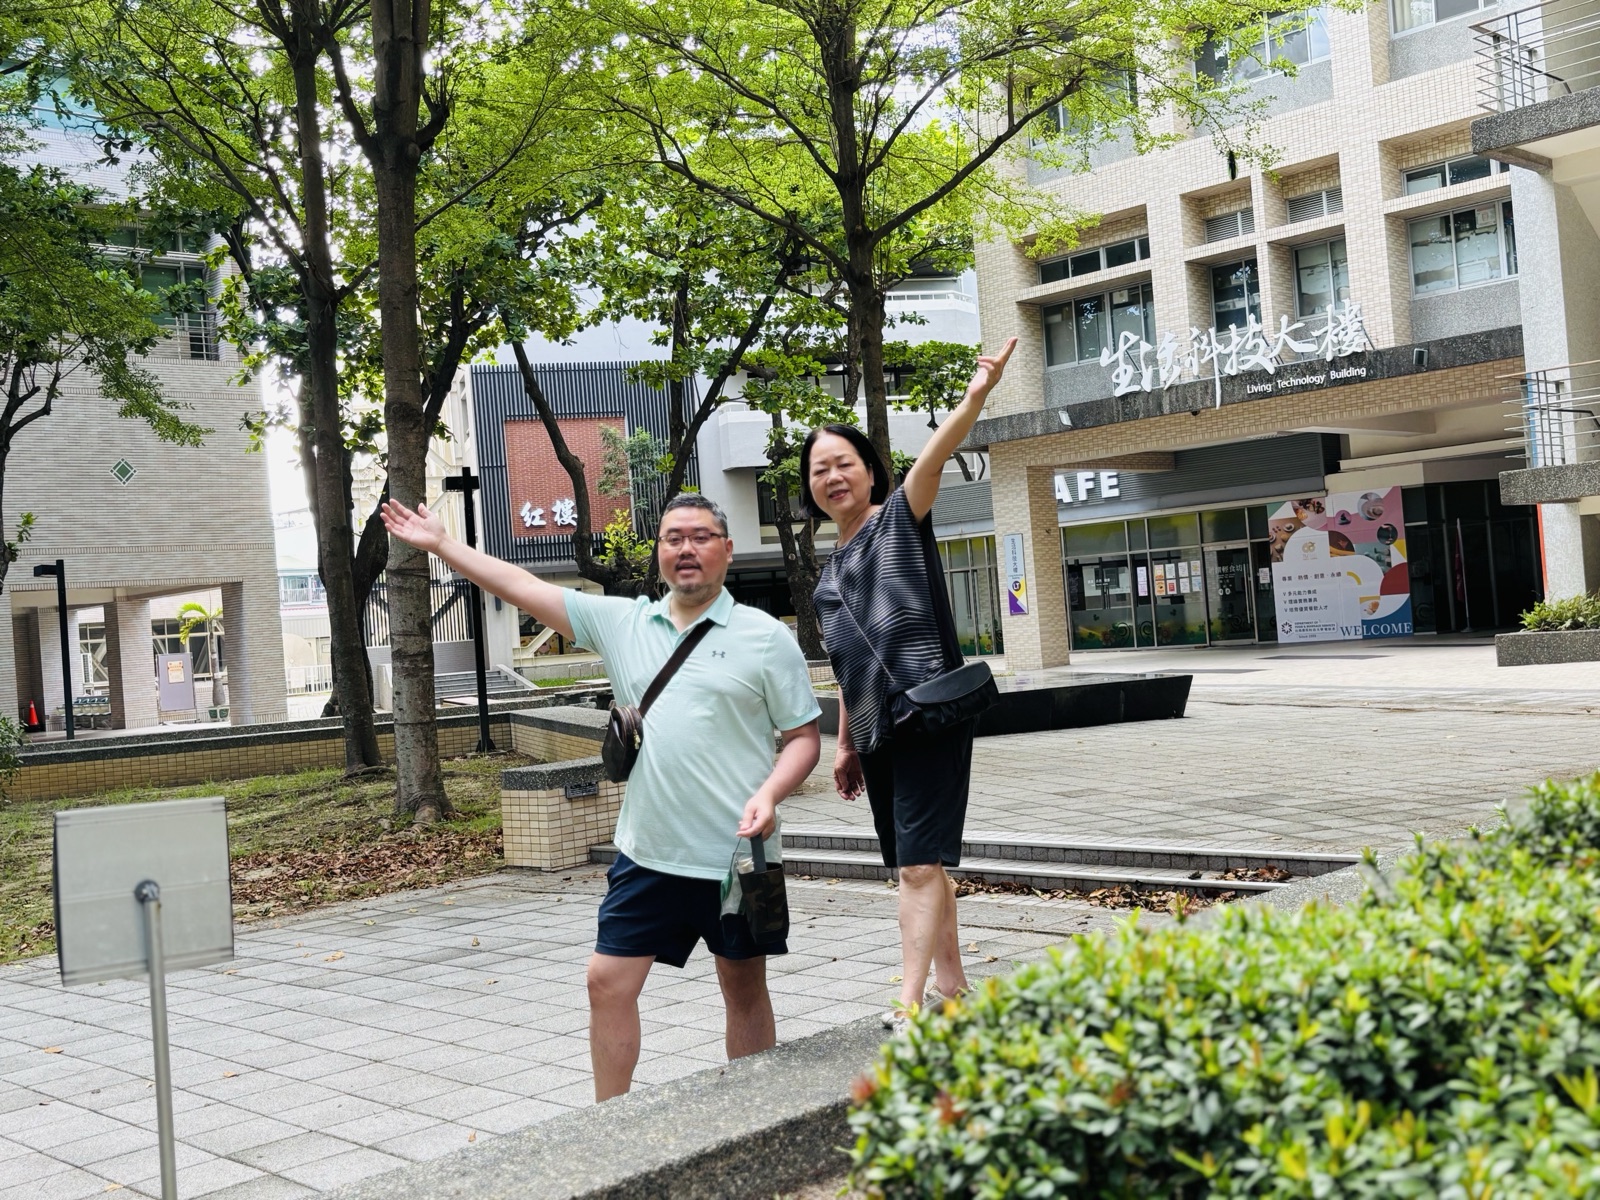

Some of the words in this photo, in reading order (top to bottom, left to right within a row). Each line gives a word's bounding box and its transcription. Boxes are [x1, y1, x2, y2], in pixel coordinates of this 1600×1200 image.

[1100, 298, 1370, 409] 生活科技大樓
[1246, 383, 1272, 394] Living
[1276, 374, 1326, 389] Technology
[1329, 367, 1367, 380] Building
[1340, 622, 1413, 637] WELCOME
